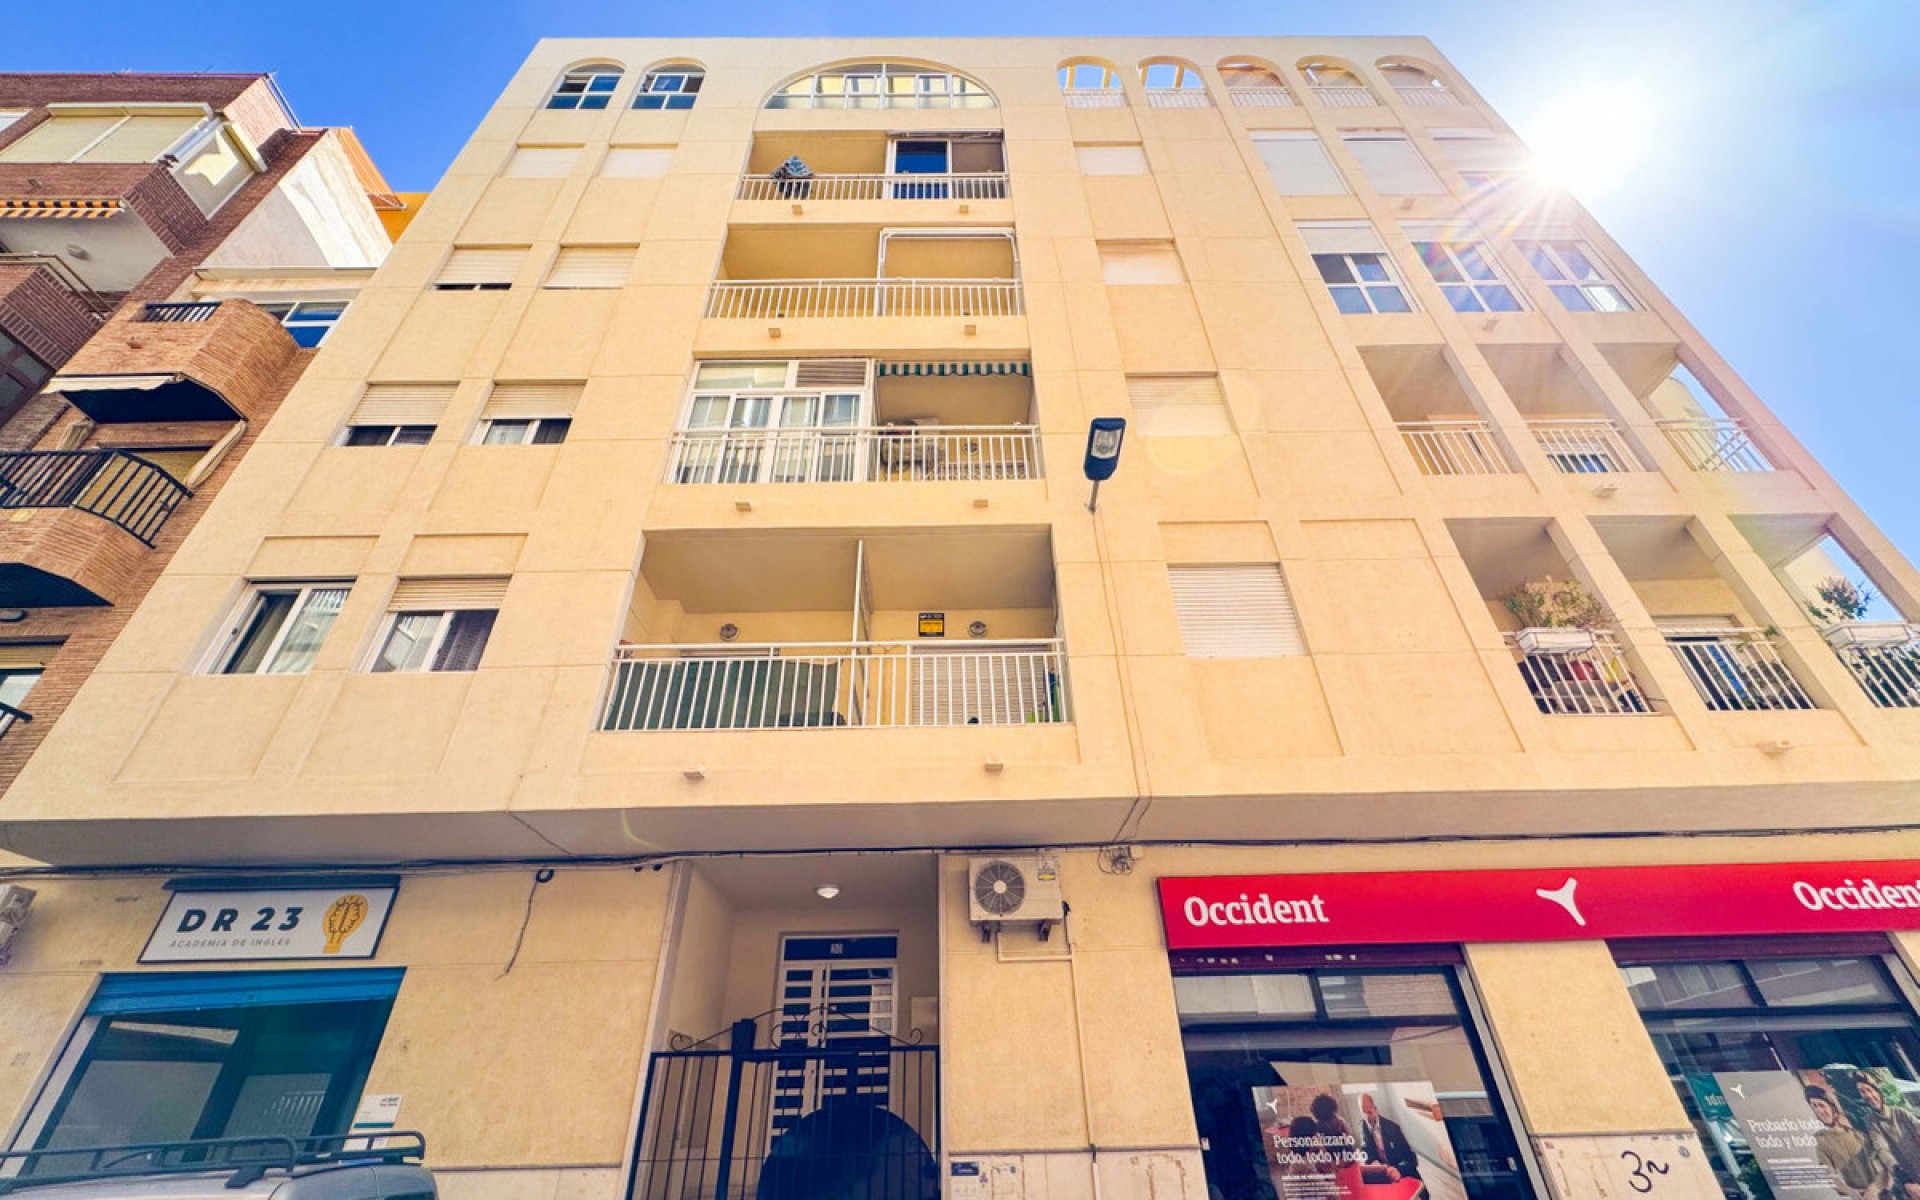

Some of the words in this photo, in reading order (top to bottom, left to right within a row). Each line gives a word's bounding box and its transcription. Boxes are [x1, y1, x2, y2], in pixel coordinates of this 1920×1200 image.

[1183, 893, 1329, 926] Occident
[176, 908, 239, 932] DR
[250, 906, 304, 931] 23
[169, 938, 227, 948] ACADEMIA
[231, 938, 247, 947] DE
[1273, 1132, 1355, 1148] Personalizarlo
[1306, 1149, 1332, 1162] todo
[1333, 1151, 1341, 1166] y
[1343, 1148, 1369, 1162] todo
